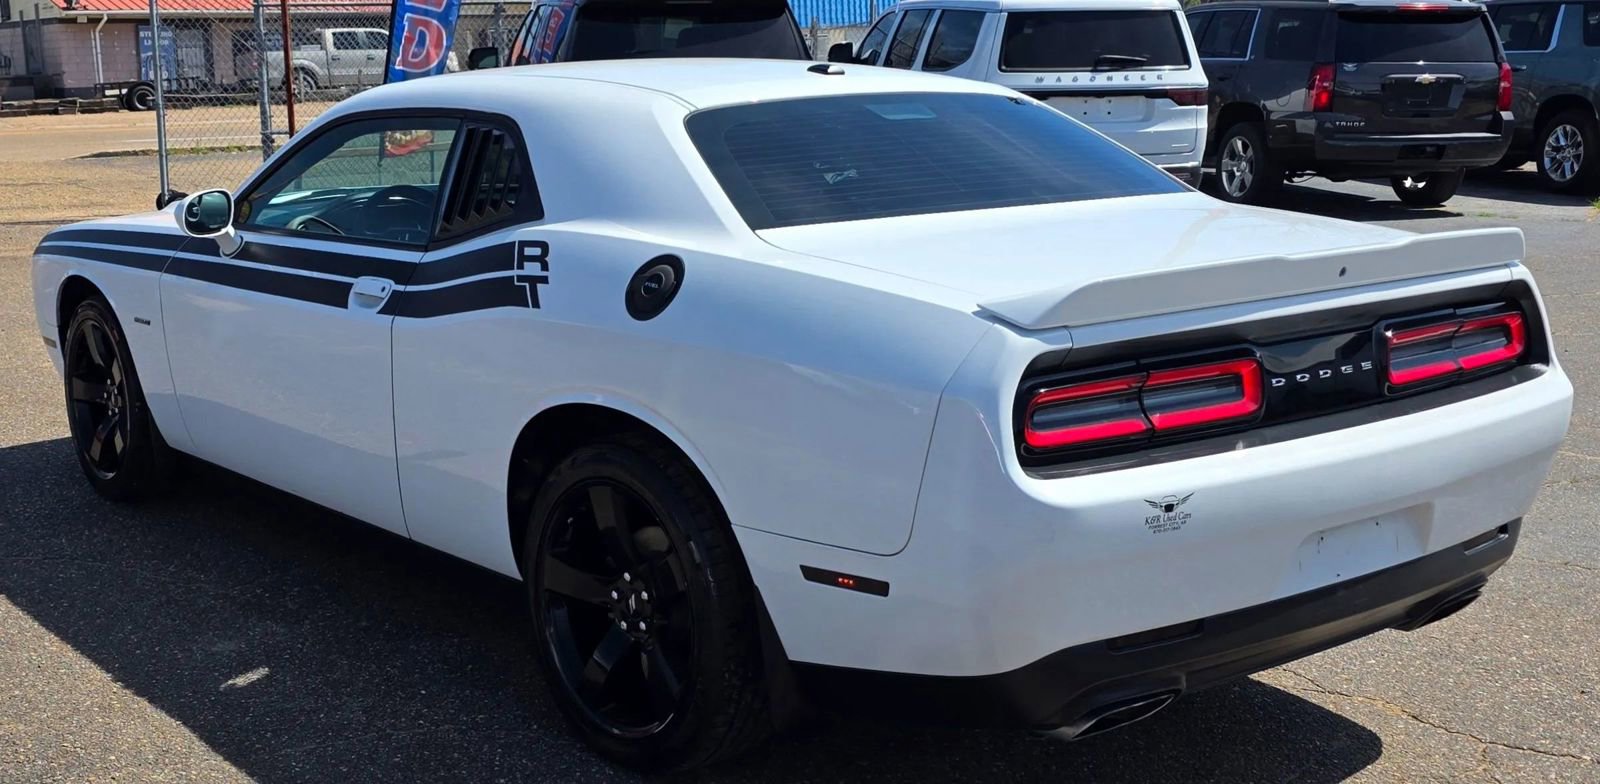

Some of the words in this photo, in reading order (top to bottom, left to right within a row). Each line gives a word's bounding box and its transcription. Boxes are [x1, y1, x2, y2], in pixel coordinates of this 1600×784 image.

[1034, 74, 1163, 83] WAGONEER
[1271, 361, 1372, 387] DODGE
[1163, 512, 1178, 522] Used
[1178, 511, 1191, 520] Cars
